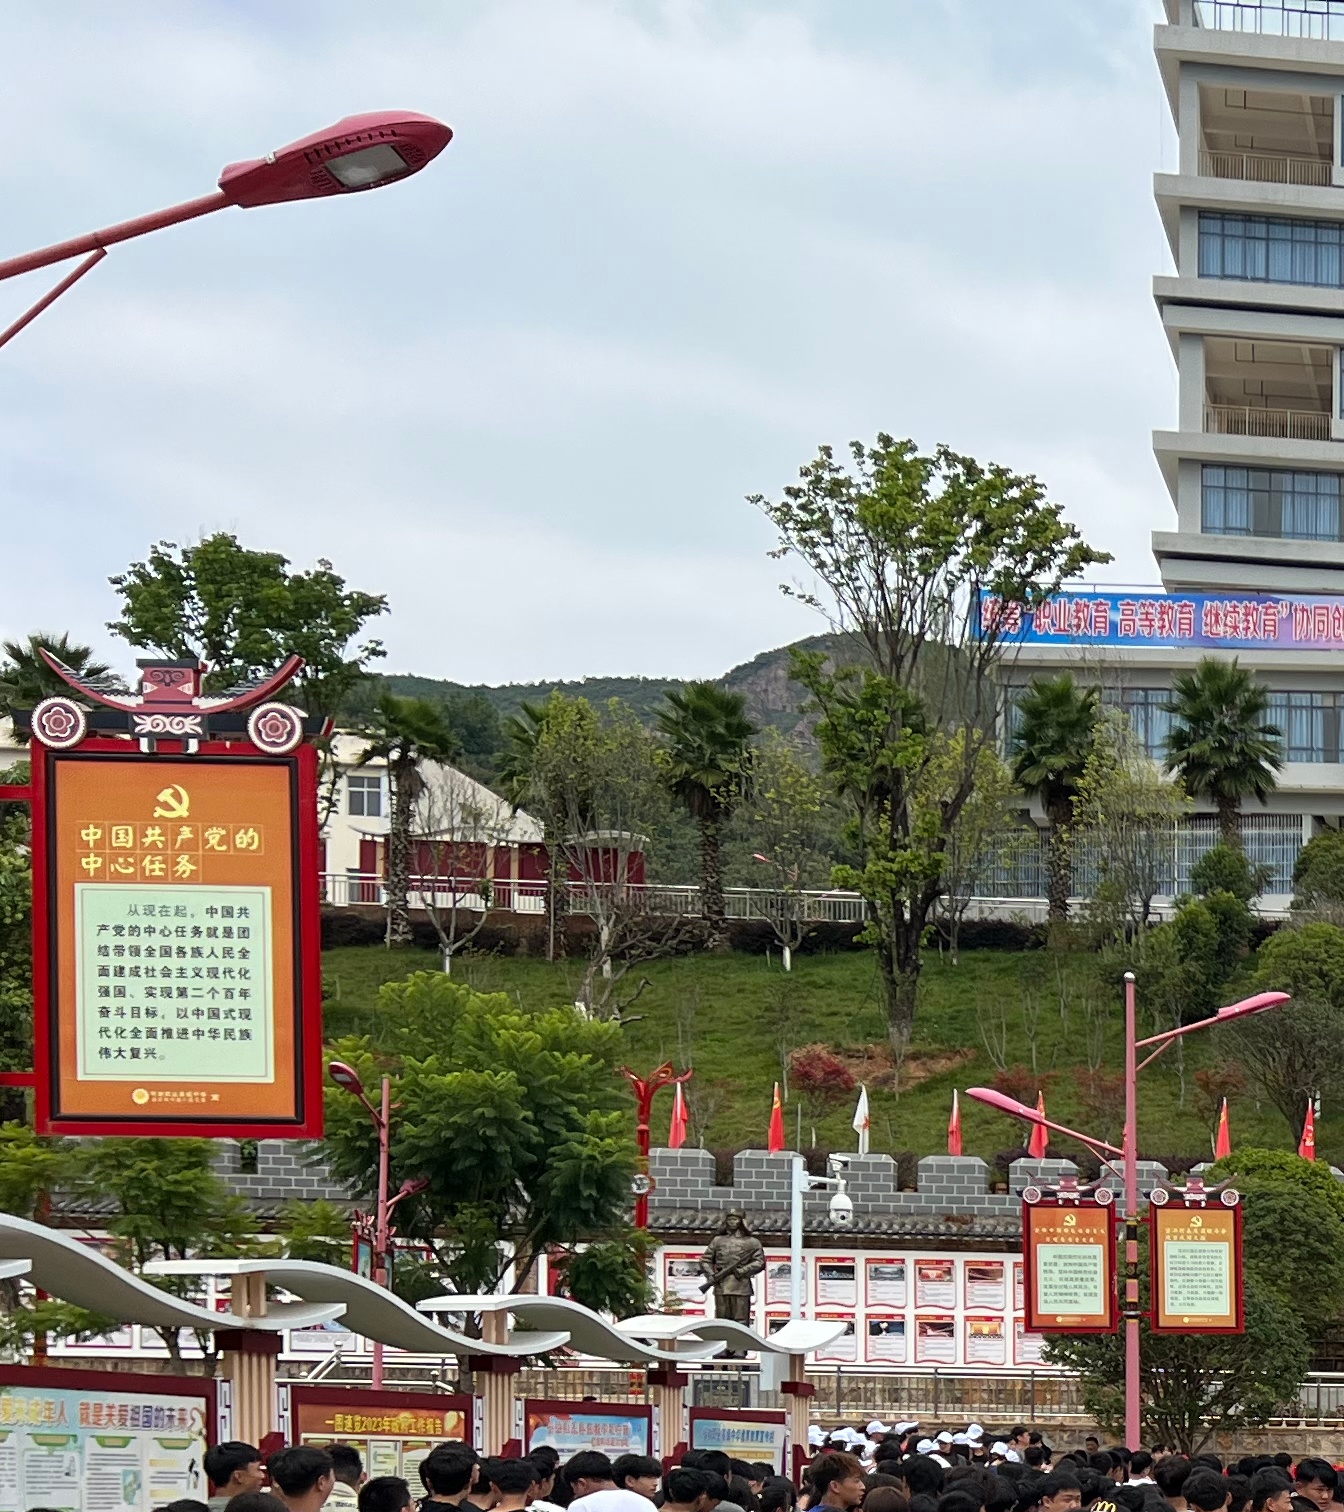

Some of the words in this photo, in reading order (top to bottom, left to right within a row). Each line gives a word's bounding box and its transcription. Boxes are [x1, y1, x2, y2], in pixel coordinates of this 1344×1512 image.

[1117, 599, 1196, 639] 高等教育
[81, 823, 259, 850] 中国共产党的
[81, 853, 198, 879] 中心任务
[96, 923, 250, 940] 产党的中心任务就是团
[97, 944, 251, 960] 结带领全国各族人民全
[97, 964, 251, 981] 面建成社会主义现代化
[98, 985, 252, 1001] 强国、实现第二个百年
[98, 1026, 253, 1042] 代化全面推进中华民族
